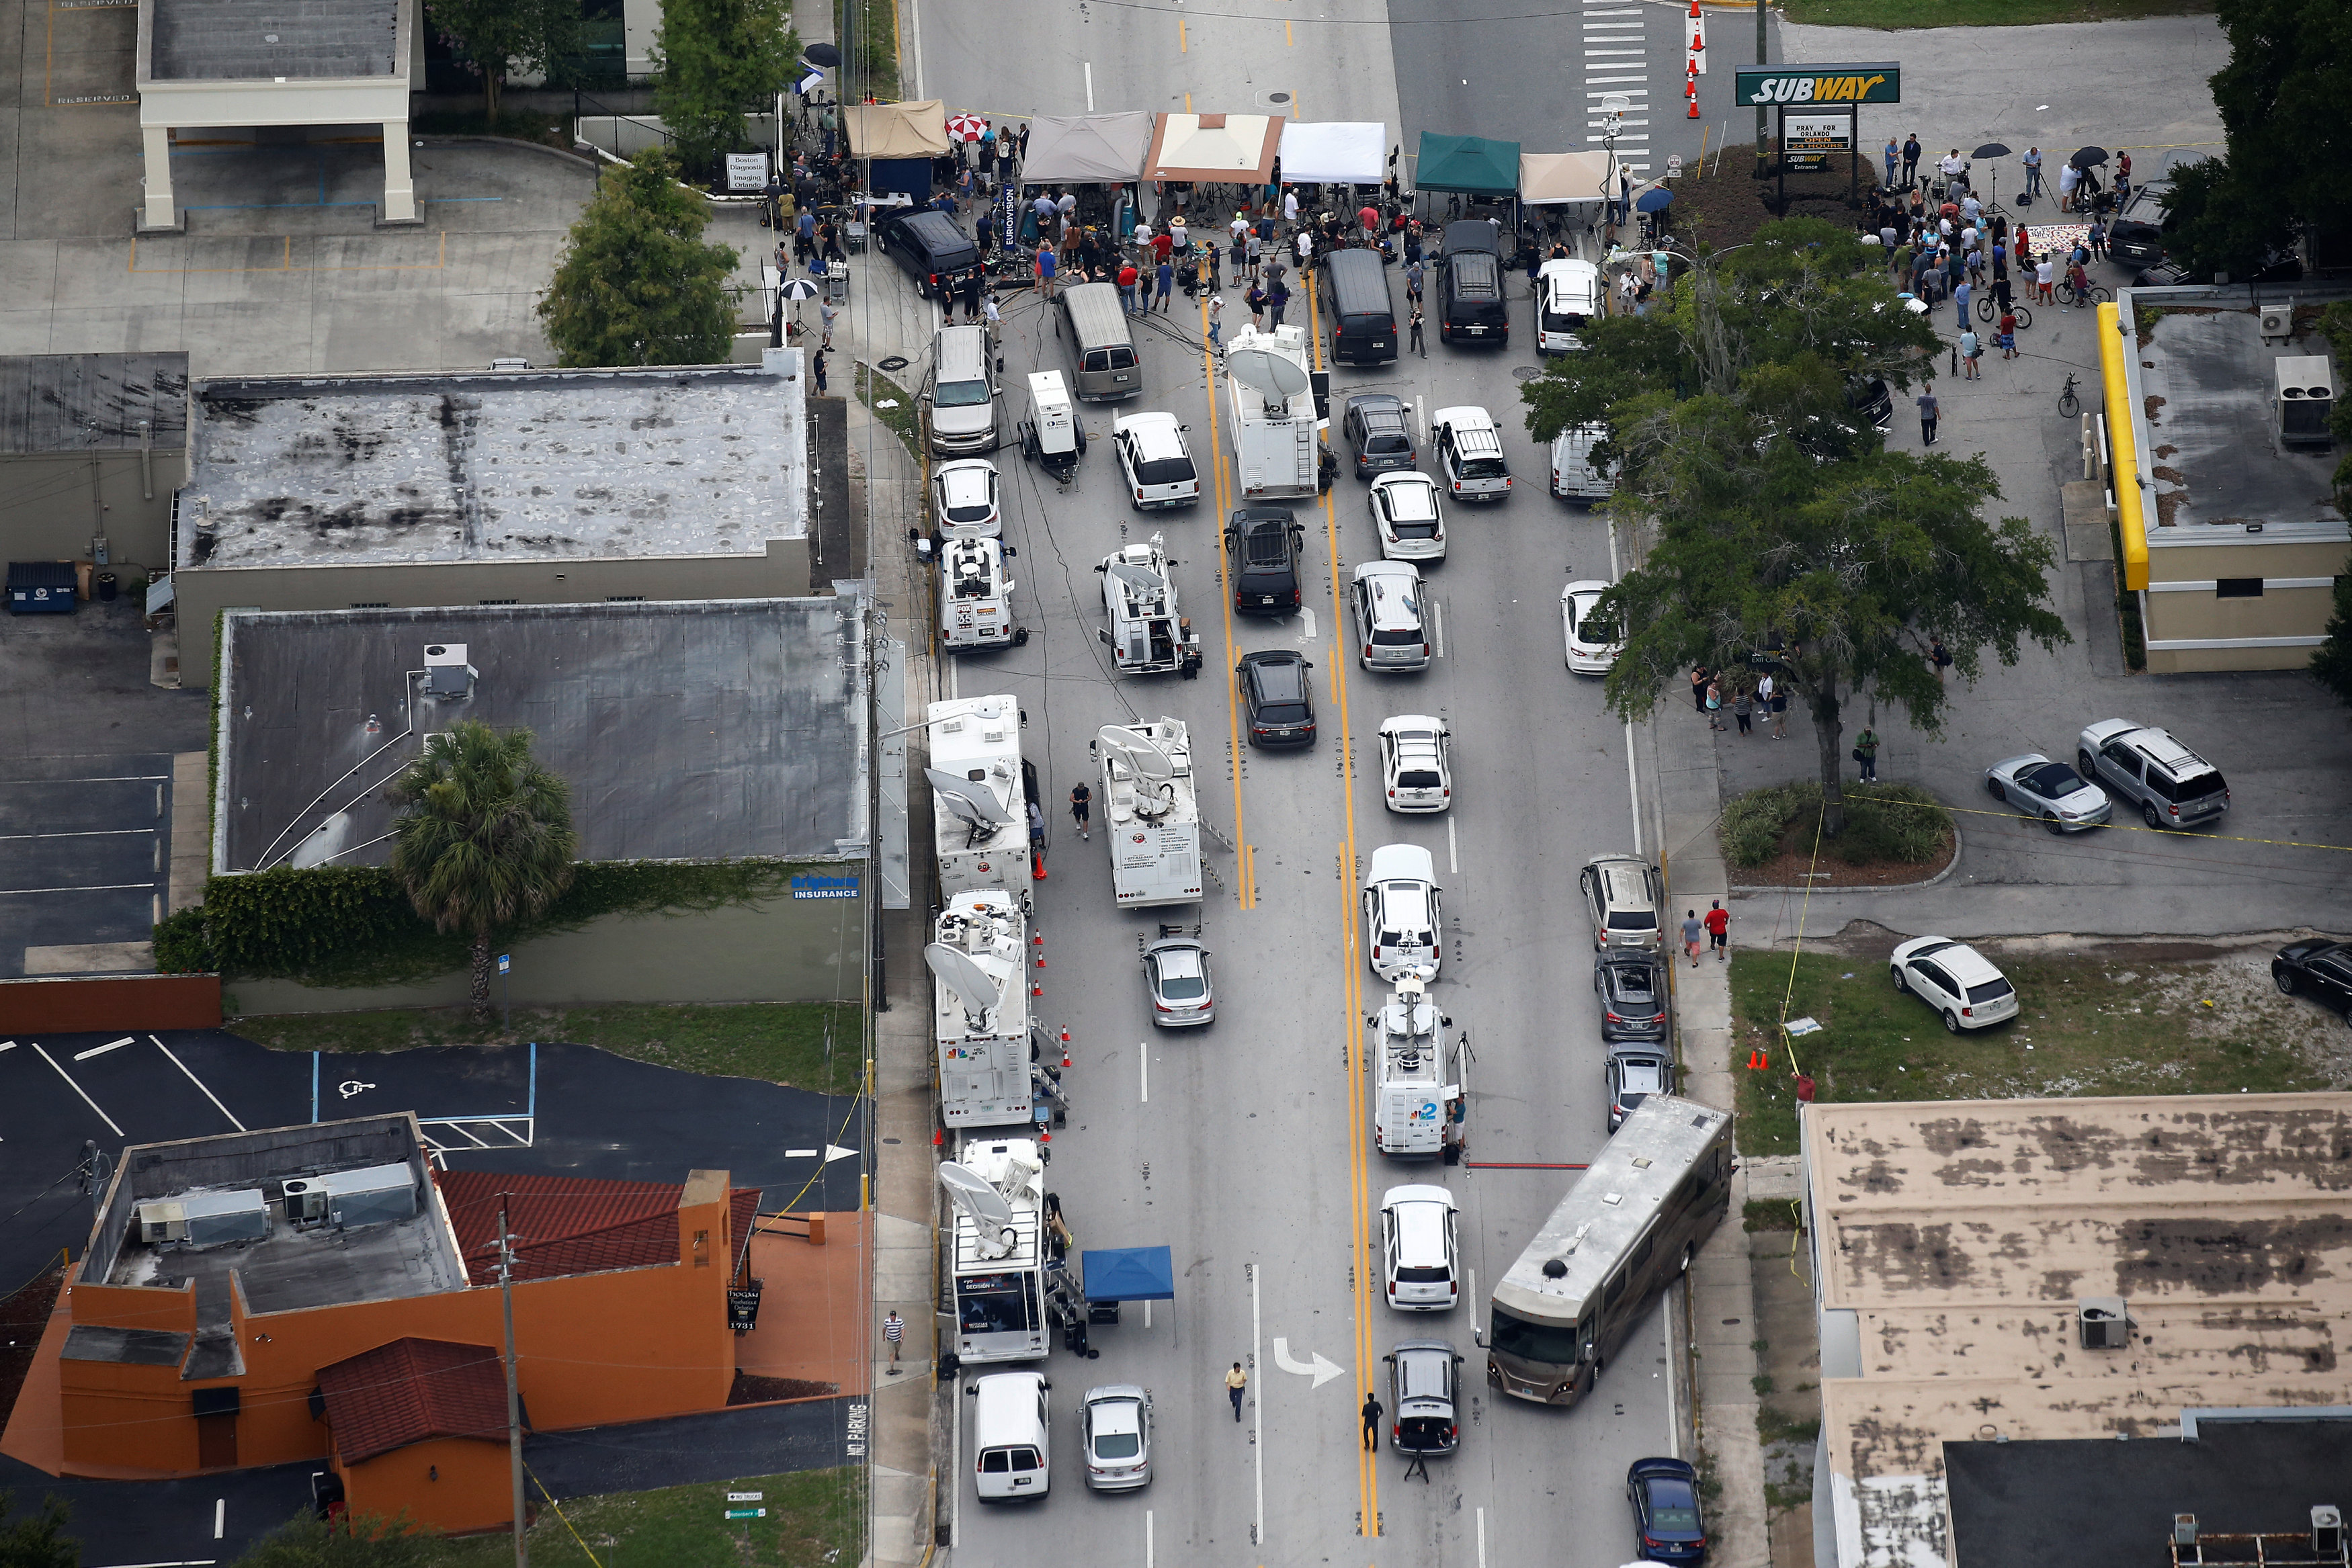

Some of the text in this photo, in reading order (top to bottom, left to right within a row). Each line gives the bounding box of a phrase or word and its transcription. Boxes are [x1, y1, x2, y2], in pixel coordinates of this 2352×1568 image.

[1750, 73, 1886, 104] SUBWAY
[58, 95, 130, 104] RESERVED
[1787, 155, 1824, 163] SUBWAY
[791, 875, 859, 889] Brightway
[795, 890, 858, 898] INSURANCE
[1422, 1102, 1437, 1120] 2
[847, 1404, 868, 1456] NO PARKING
